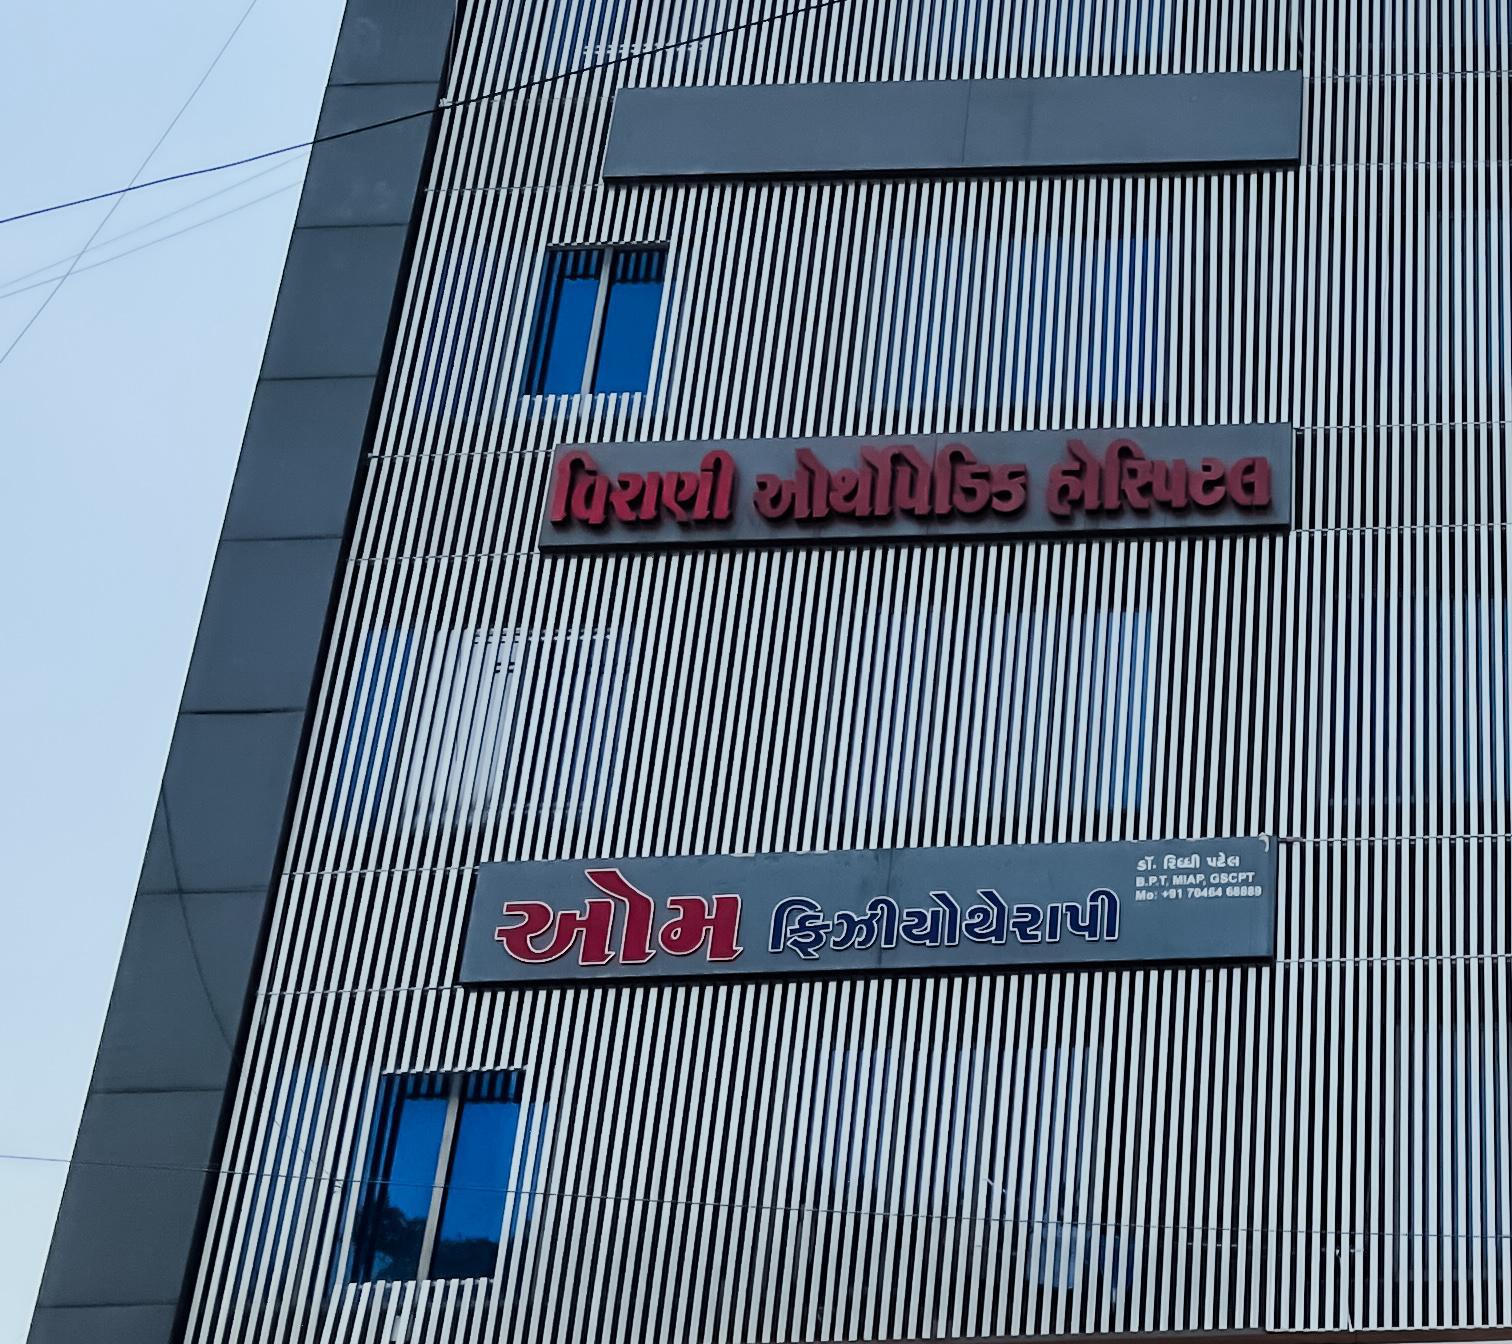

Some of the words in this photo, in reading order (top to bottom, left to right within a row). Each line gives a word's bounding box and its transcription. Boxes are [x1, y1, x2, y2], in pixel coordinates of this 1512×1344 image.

[550, 450, 737, 525] વિરાણી
[1047, 438, 1272, 516] હોસ્પિટલ
[1206, 851, 1240, 867] પટેલ
[1209, 871, 1256, 884] GSCPT
[494, 868, 744, 966] ઓમ
